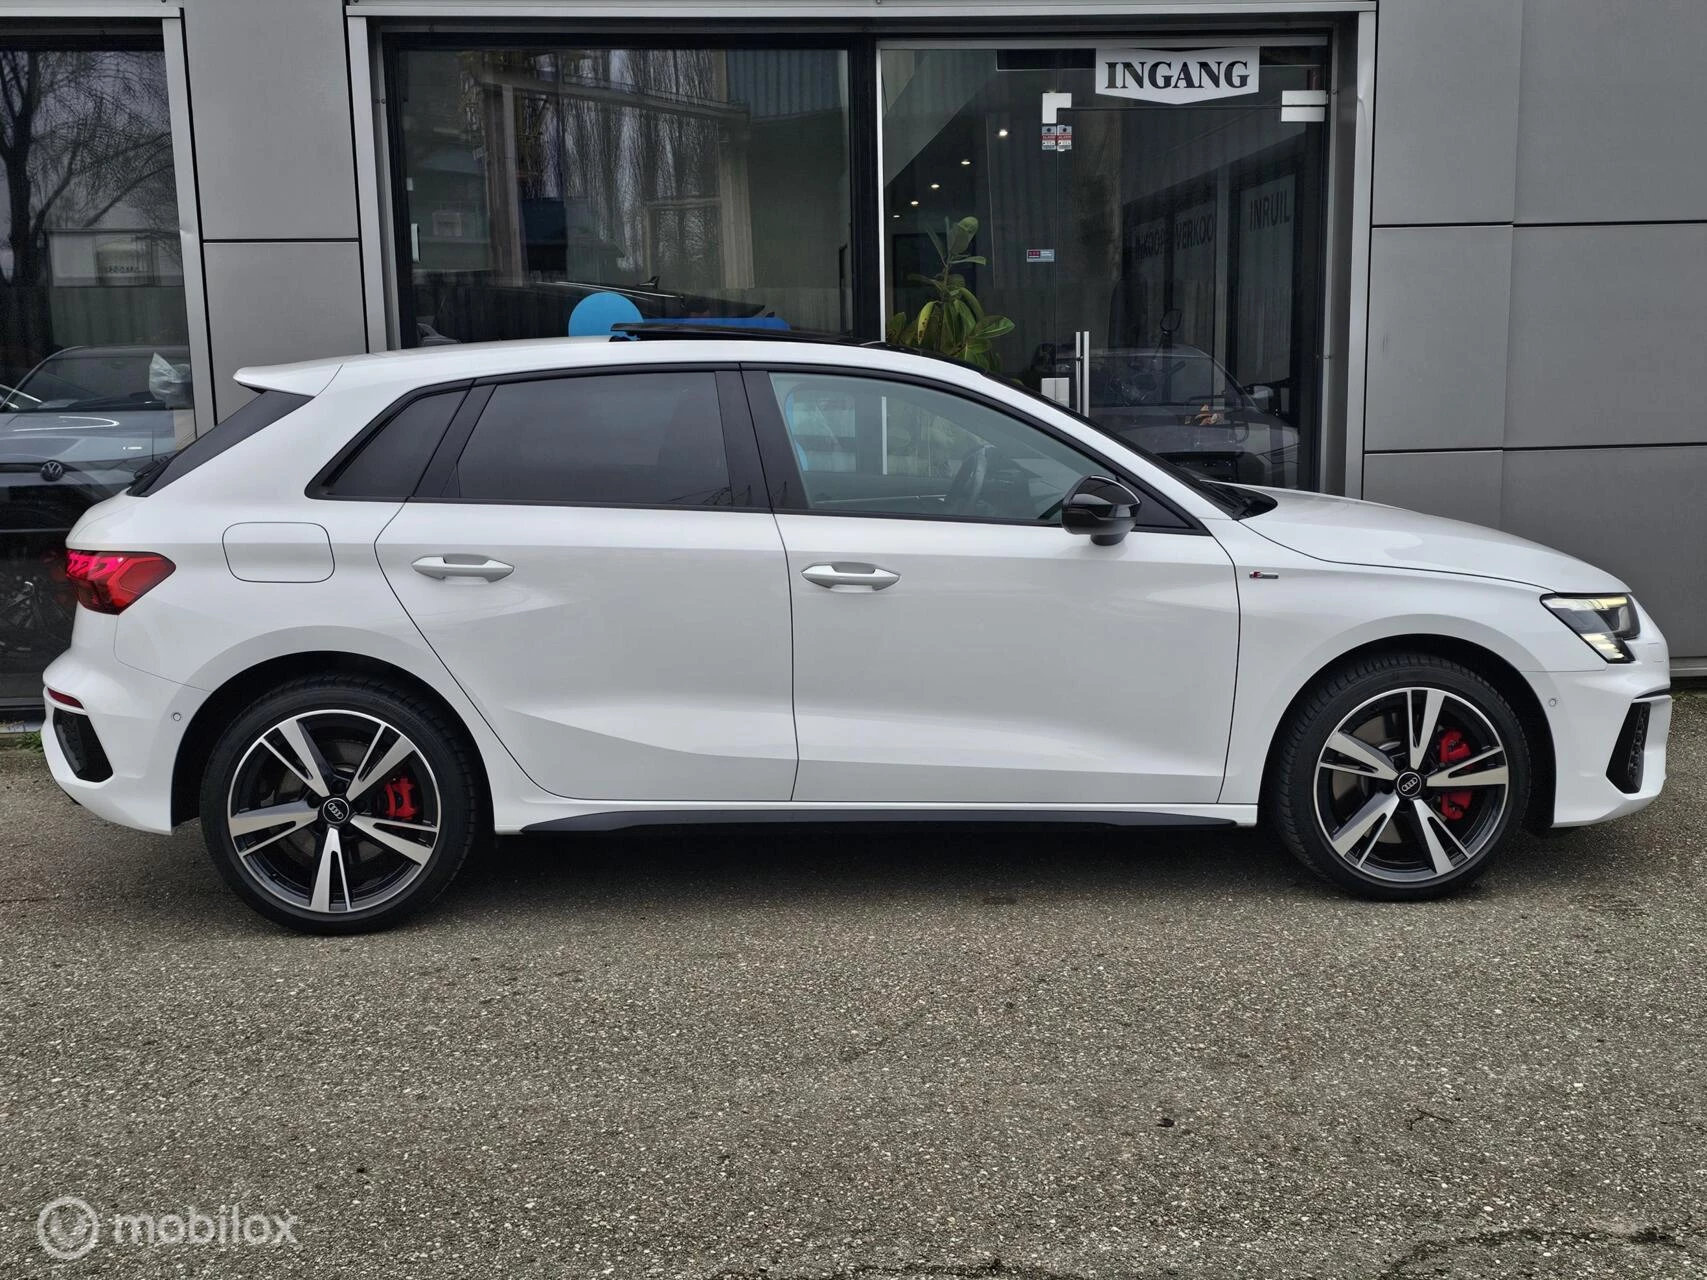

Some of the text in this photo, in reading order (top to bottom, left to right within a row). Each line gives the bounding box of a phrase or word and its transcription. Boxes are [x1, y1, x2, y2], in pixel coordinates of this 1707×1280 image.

[1105, 61, 1249, 89] INGANG
[1250, 189, 1290, 232] INRUIL
[1176, 213, 1214, 250] VERKOO
